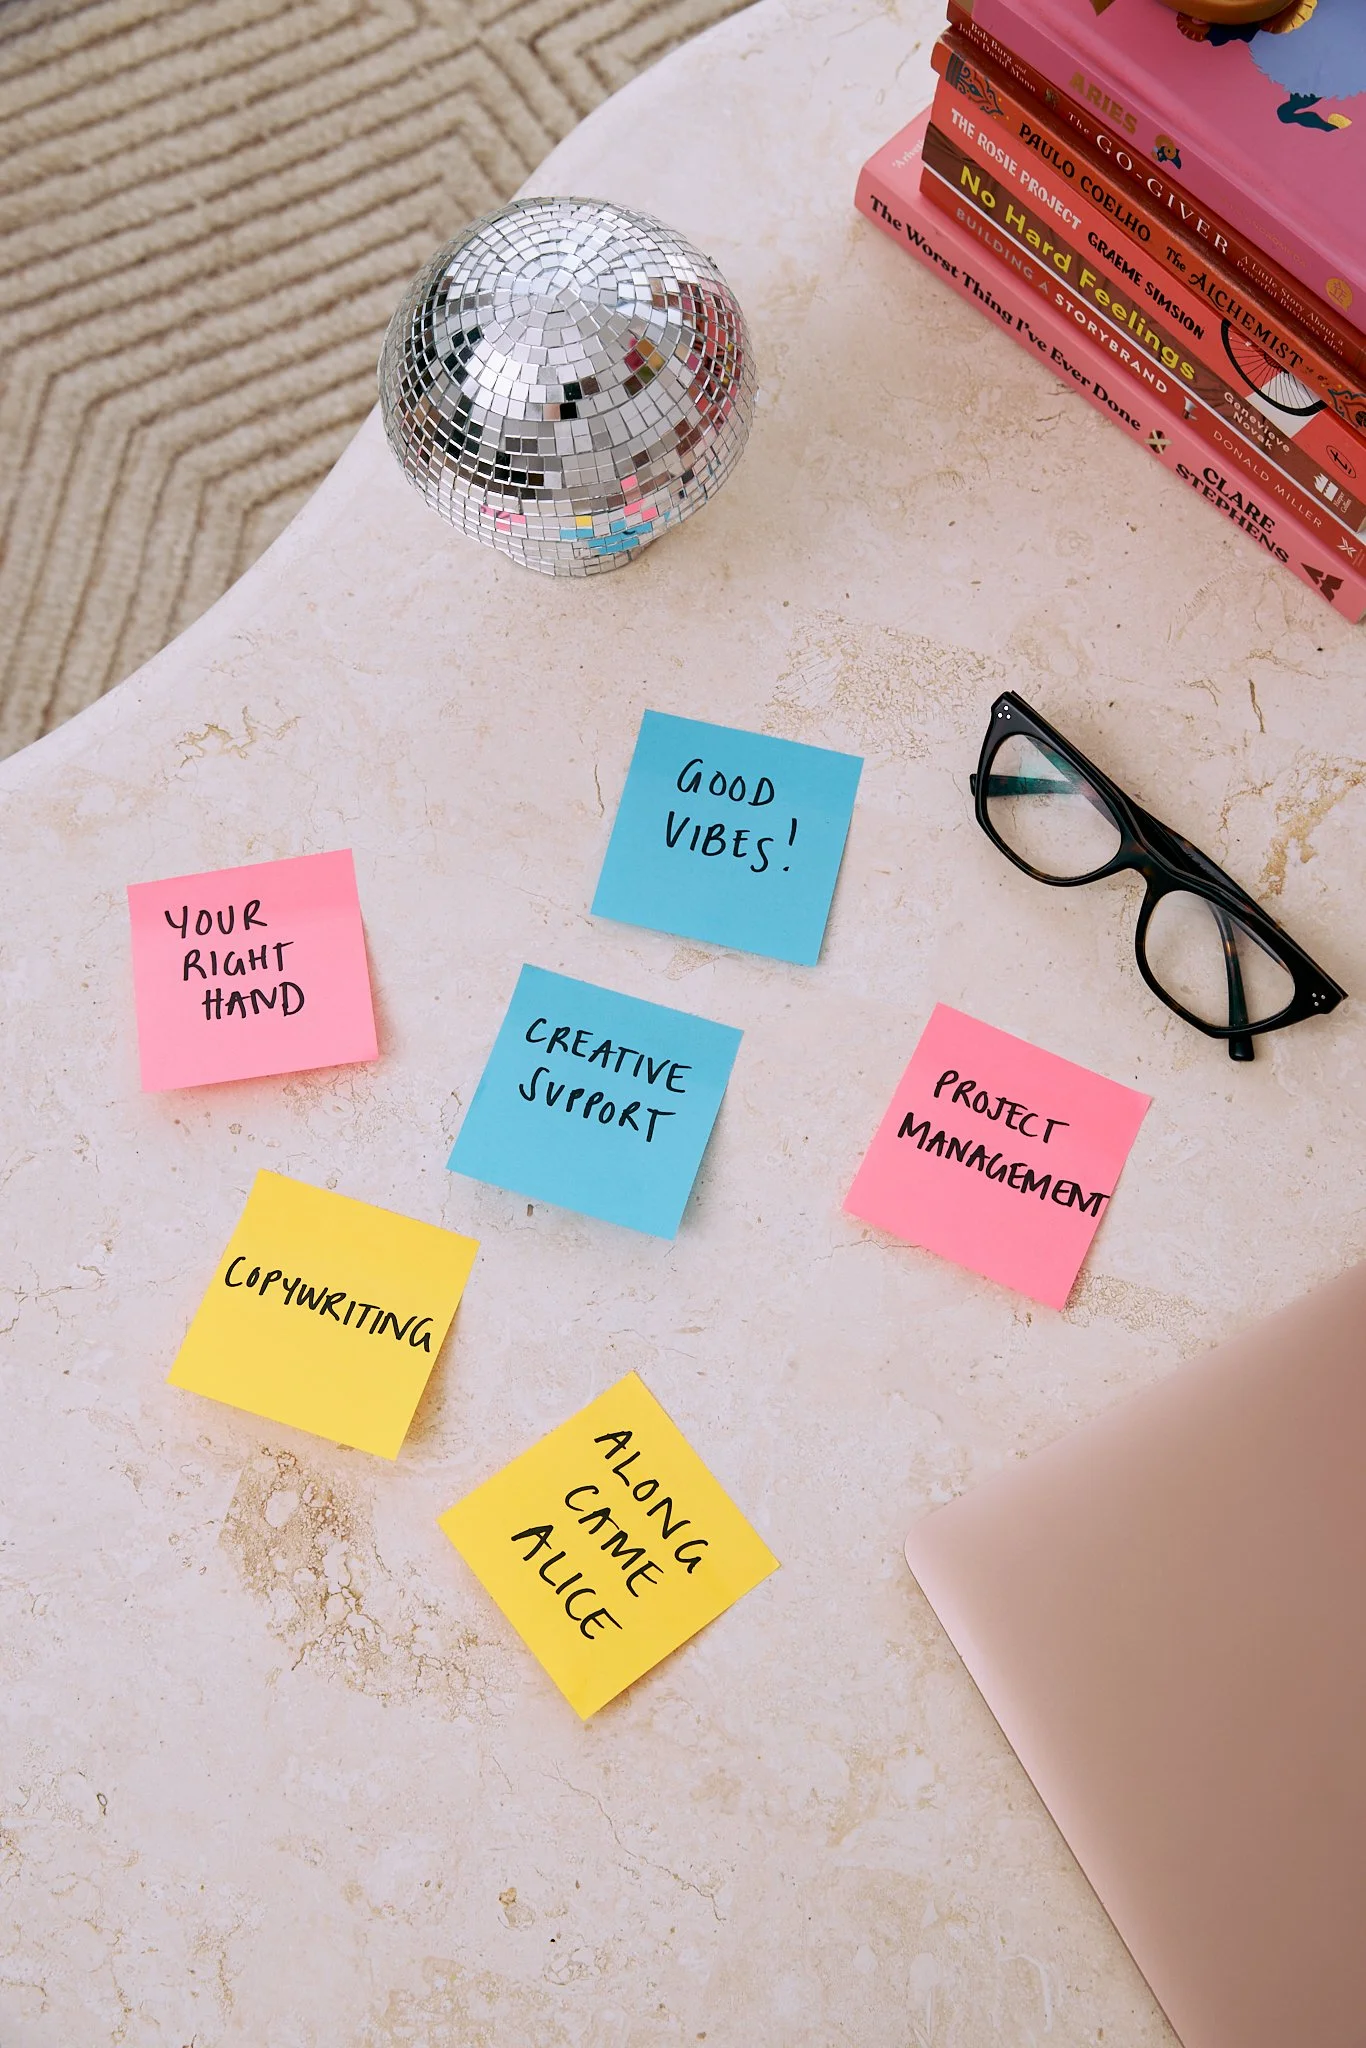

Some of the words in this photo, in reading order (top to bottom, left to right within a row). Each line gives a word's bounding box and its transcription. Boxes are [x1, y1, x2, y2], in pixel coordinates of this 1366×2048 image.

[958, 23, 979, 44] John
[982, 42, 1008, 68] David
[1011, 66, 1036, 92] Mann
[971, 23, 988, 42] Bob
[991, 40, 1012, 64] Burg
[1015, 63, 1027, 74] and
[1069, 71, 1138, 136] ARIES
[951, 108, 976, 139] THE
[977, 132, 1018, 177] ROSIE
[1019, 170, 1082, 230] PROJECT
[1019, 122, 1075, 178] PAULO
[1080, 175, 1151, 242] COELHO
[1068, 111, 1090, 134] The
[1096, 134, 1228, 256] GO-GIVER
[870, 195, 902, 231] The
[906, 223, 959, 279] Worst
[962, 272, 1013, 326] Thing
[1016, 319, 1047, 352] I've
[1050, 347, 1091, 388] Ever
[1092, 383, 1141, 431] Done
[956, 207, 1035, 280] BUILDING
[1037, 282, 1049, 294] A
[1055, 293, 1167, 393] STORYBRAND
[960, 165, 996, 209] No
[1005, 204, 1072, 274] Hard
[1079, 267, 1195, 381] Feelings
[1087, 231, 1143, 287] GRAEME
[1145, 281, 1205, 341] SIMSION
[1166, 246, 1186, 272] The
[1188, 273, 1303, 369] ALCHEMIST
[1237, 260, 1278, 298] Powerful
[1280, 297, 1320, 336] Business
[1323, 334, 1344, 356] Idea
[1241, 256, 1249, 265] A
[1252, 262, 1277, 289] Little
[1281, 288, 1306, 312] Story
[1307, 312, 1335, 338] About
[1224, 391, 1290, 453] Genevieve
[1233, 412, 1273, 451] Novak
[1176, 463, 1289, 563] STEPHENS
[1203, 467, 1276, 534] CLARE
[1214, 430, 1270, 482] DONALD
[1274, 484, 1322, 528] MILLER
[676, 758, 775, 807] GOOD
[665, 810, 797, 873] VIBES!
[164, 899, 268, 939] YOUR
[183, 941, 294, 981] RIGHT
[201, 981, 305, 1021] HAND
[525, 1017, 692, 1094] CREATIVE
[518, 1066, 676, 1143] SUPPORT
[933, 1070, 1070, 1144] PROJECT
[897, 1112, 1110, 1217] MANAGEMENT
[224, 1256, 434, 1353] COPYWRITING
[565, 1485, 664, 1598] CAME
[594, 1430, 709, 1574] ALONG
[510, 1524, 623, 1640] ALICE
